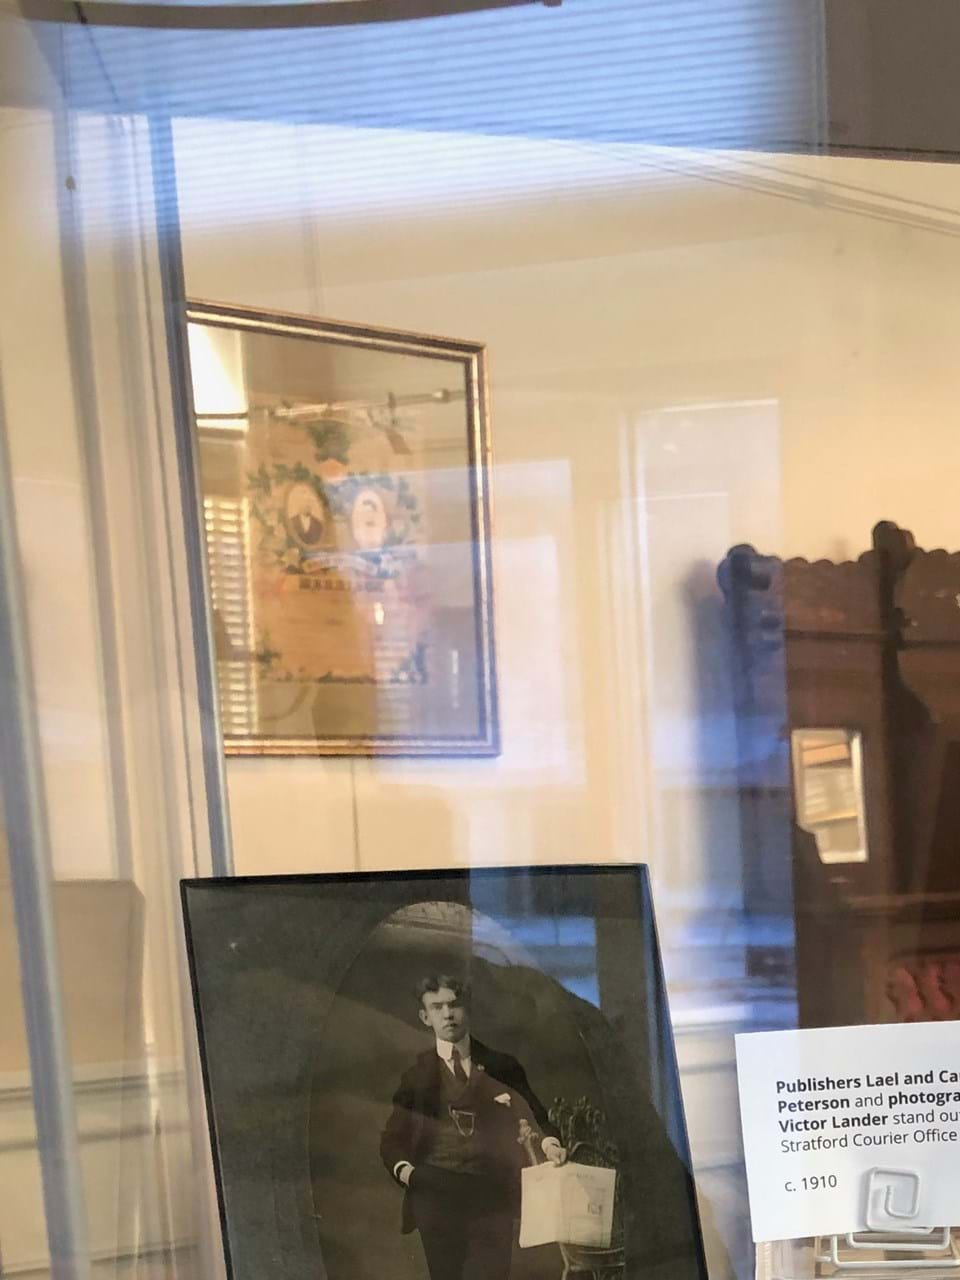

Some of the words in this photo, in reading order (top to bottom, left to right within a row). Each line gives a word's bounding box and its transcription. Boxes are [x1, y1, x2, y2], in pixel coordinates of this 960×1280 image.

[776, 1077, 861, 1094] Publishers
[866, 1072, 899, 1088] Lael
[904, 1070, 934, 1085] and
[777, 1097, 850, 1114] Peterson
[855, 1094, 883, 1108] and
[779, 1118, 827, 1133] Victor
[832, 1112, 889, 1129] Lander
[892, 1109, 935, 1126] stand
[780, 1133, 848, 1154] Stratford
[853, 1131, 908, 1148] Courier
[913, 1128, 958, 1144] Office
[784, 1180, 797, 1193] c.
[801, 1174, 838, 1191] 1910
